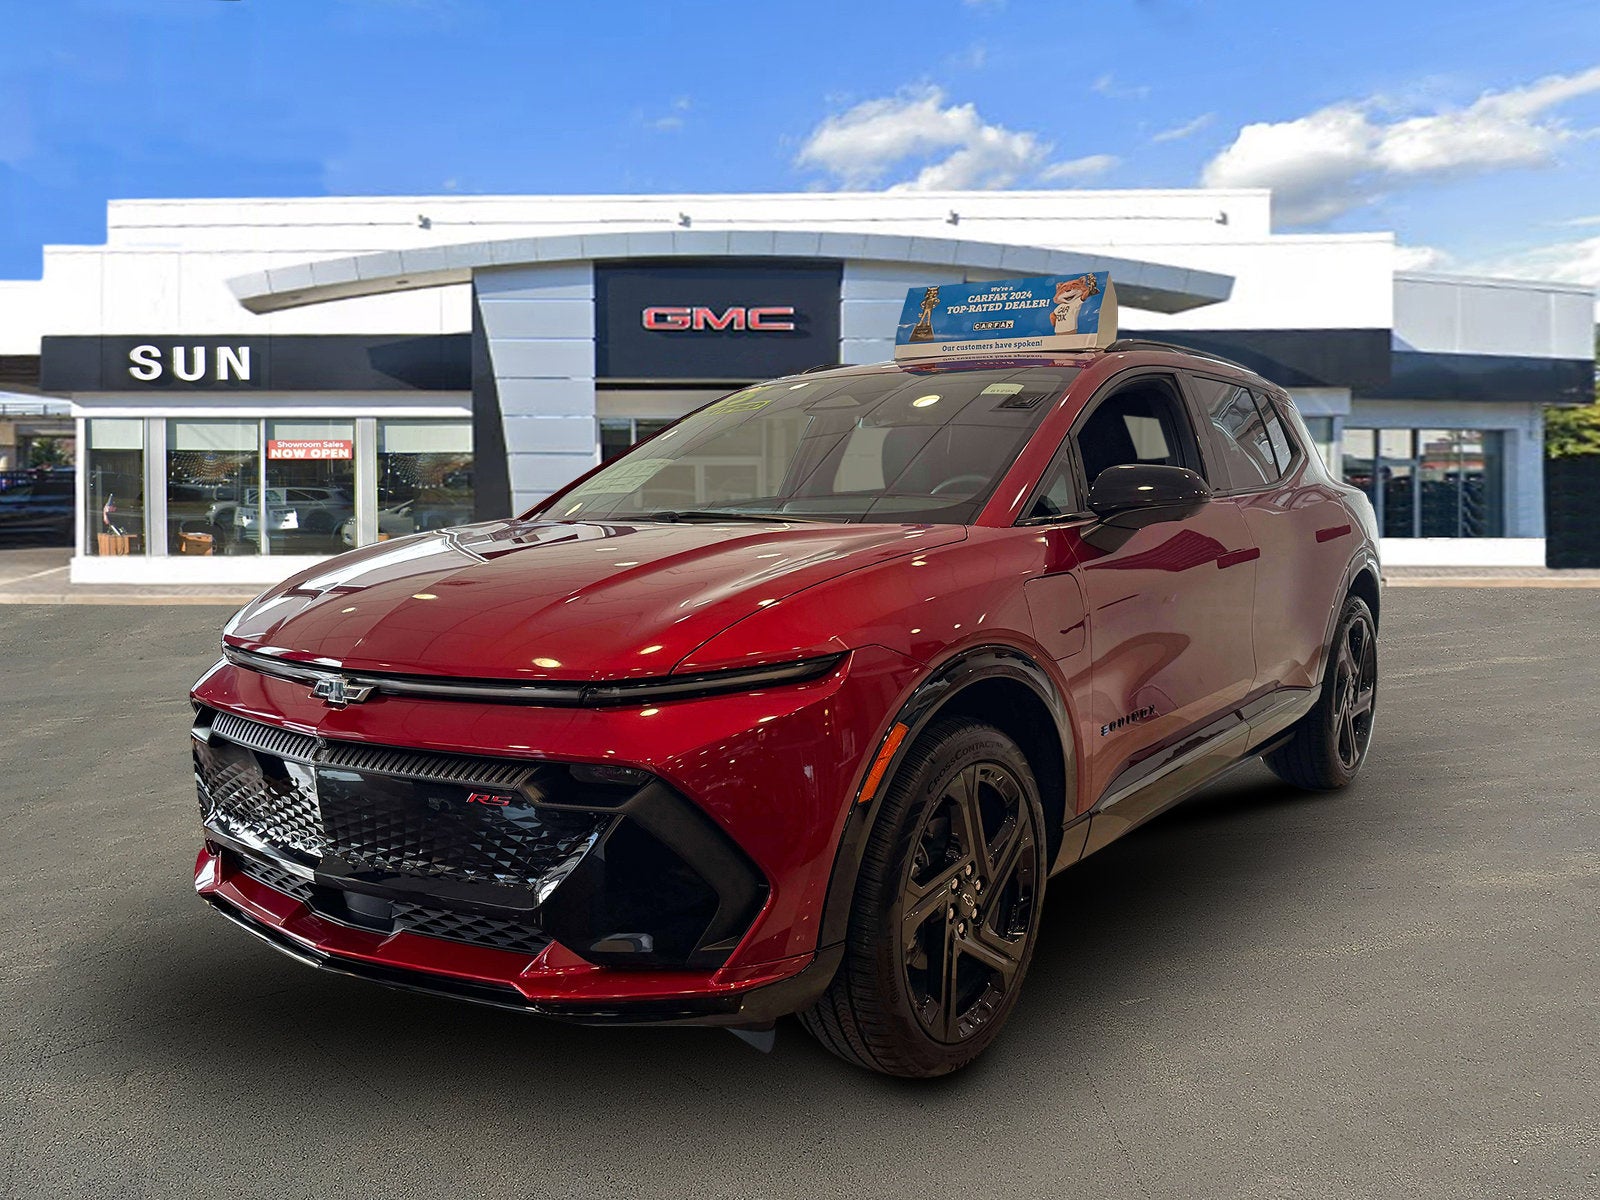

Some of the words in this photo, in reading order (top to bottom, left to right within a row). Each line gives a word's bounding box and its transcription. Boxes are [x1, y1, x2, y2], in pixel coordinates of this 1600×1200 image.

[968, 293, 1008, 303] CARFAX
[1009, 291, 1032, 300] 2024
[947, 303, 1002, 314] TOP-RATED
[1004, 299, 1050, 310] DEALER!
[642, 307, 794, 330] GMC
[973, 320, 1014, 331] CARFAX
[956, 343, 993, 351] customers
[995, 341, 1012, 349] have
[1013, 340, 1043, 349] spoken!
[128, 345, 250, 381] SUN
[271, 449, 306, 458] NOW
[310, 449, 349, 458] OPEN
[1101, 704, 1155, 737] EQUINOX
[466, 792, 512, 806] RS
